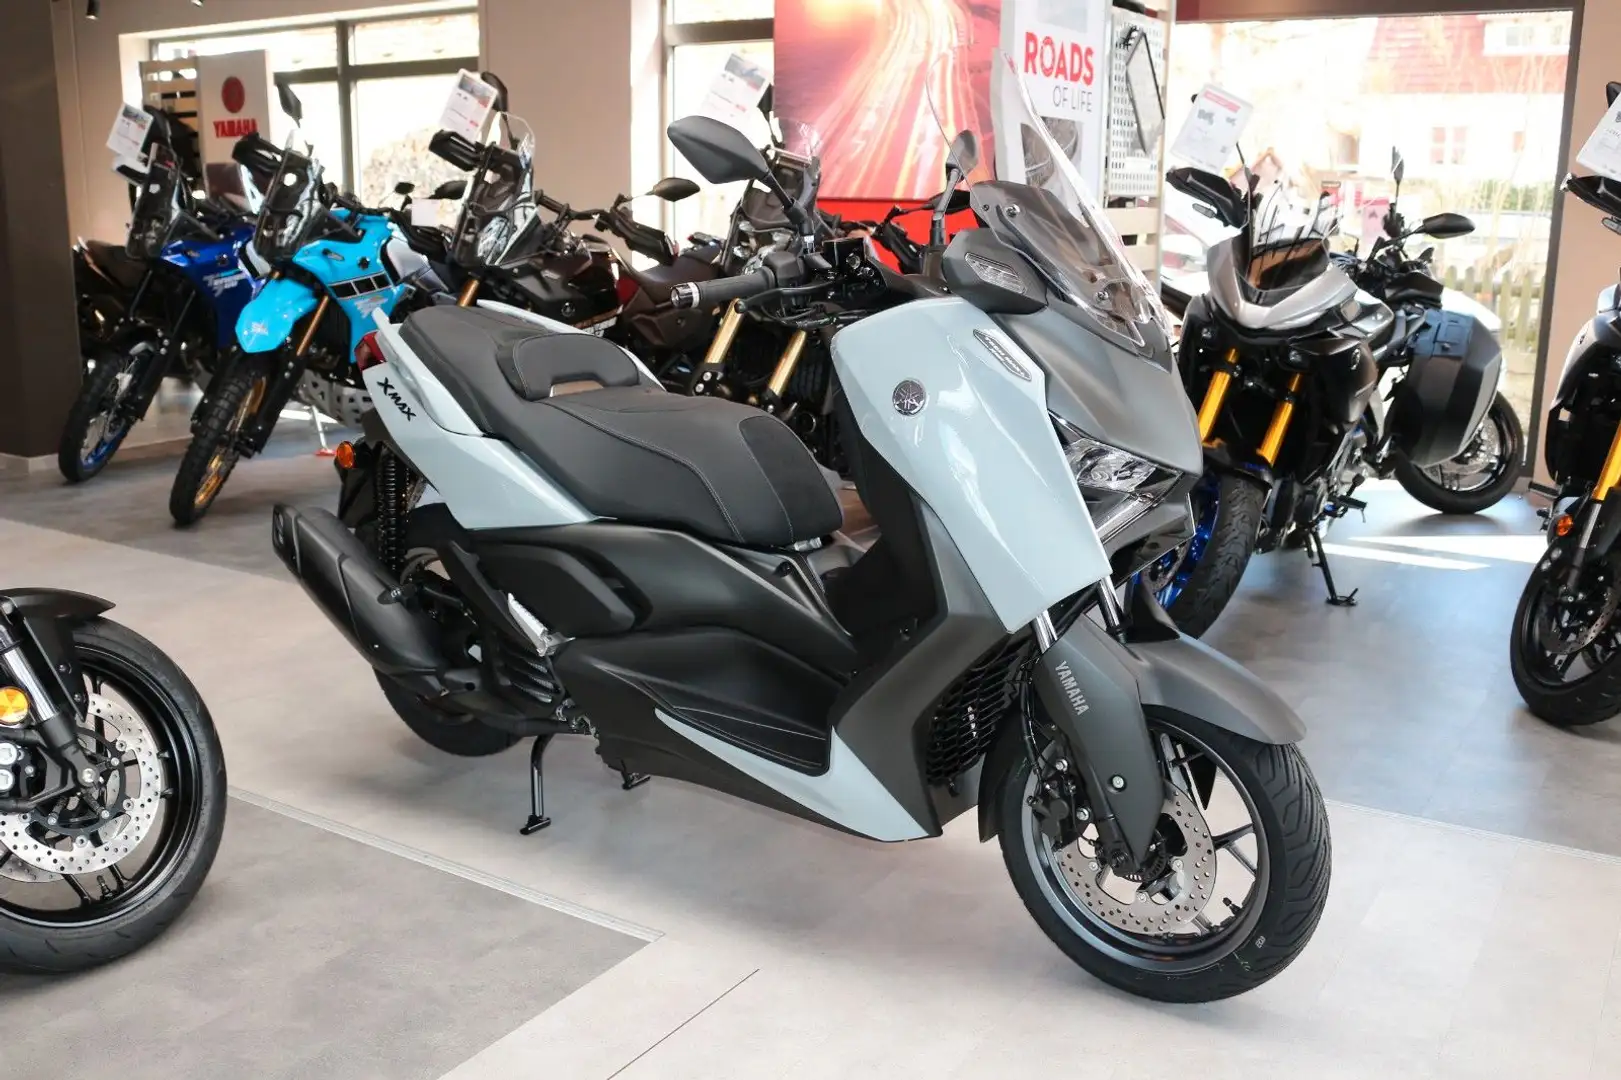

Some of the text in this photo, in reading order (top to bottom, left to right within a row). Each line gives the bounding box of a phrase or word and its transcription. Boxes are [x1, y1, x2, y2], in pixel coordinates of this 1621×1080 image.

[1024, 31, 1094, 86] ROADS
[1053, 85, 1093, 112] OF LIFE
[213, 117, 258, 138] YAMAHA
[376, 376, 417, 422] XMAX
[1055, 660, 1089, 715] YAMAHA
